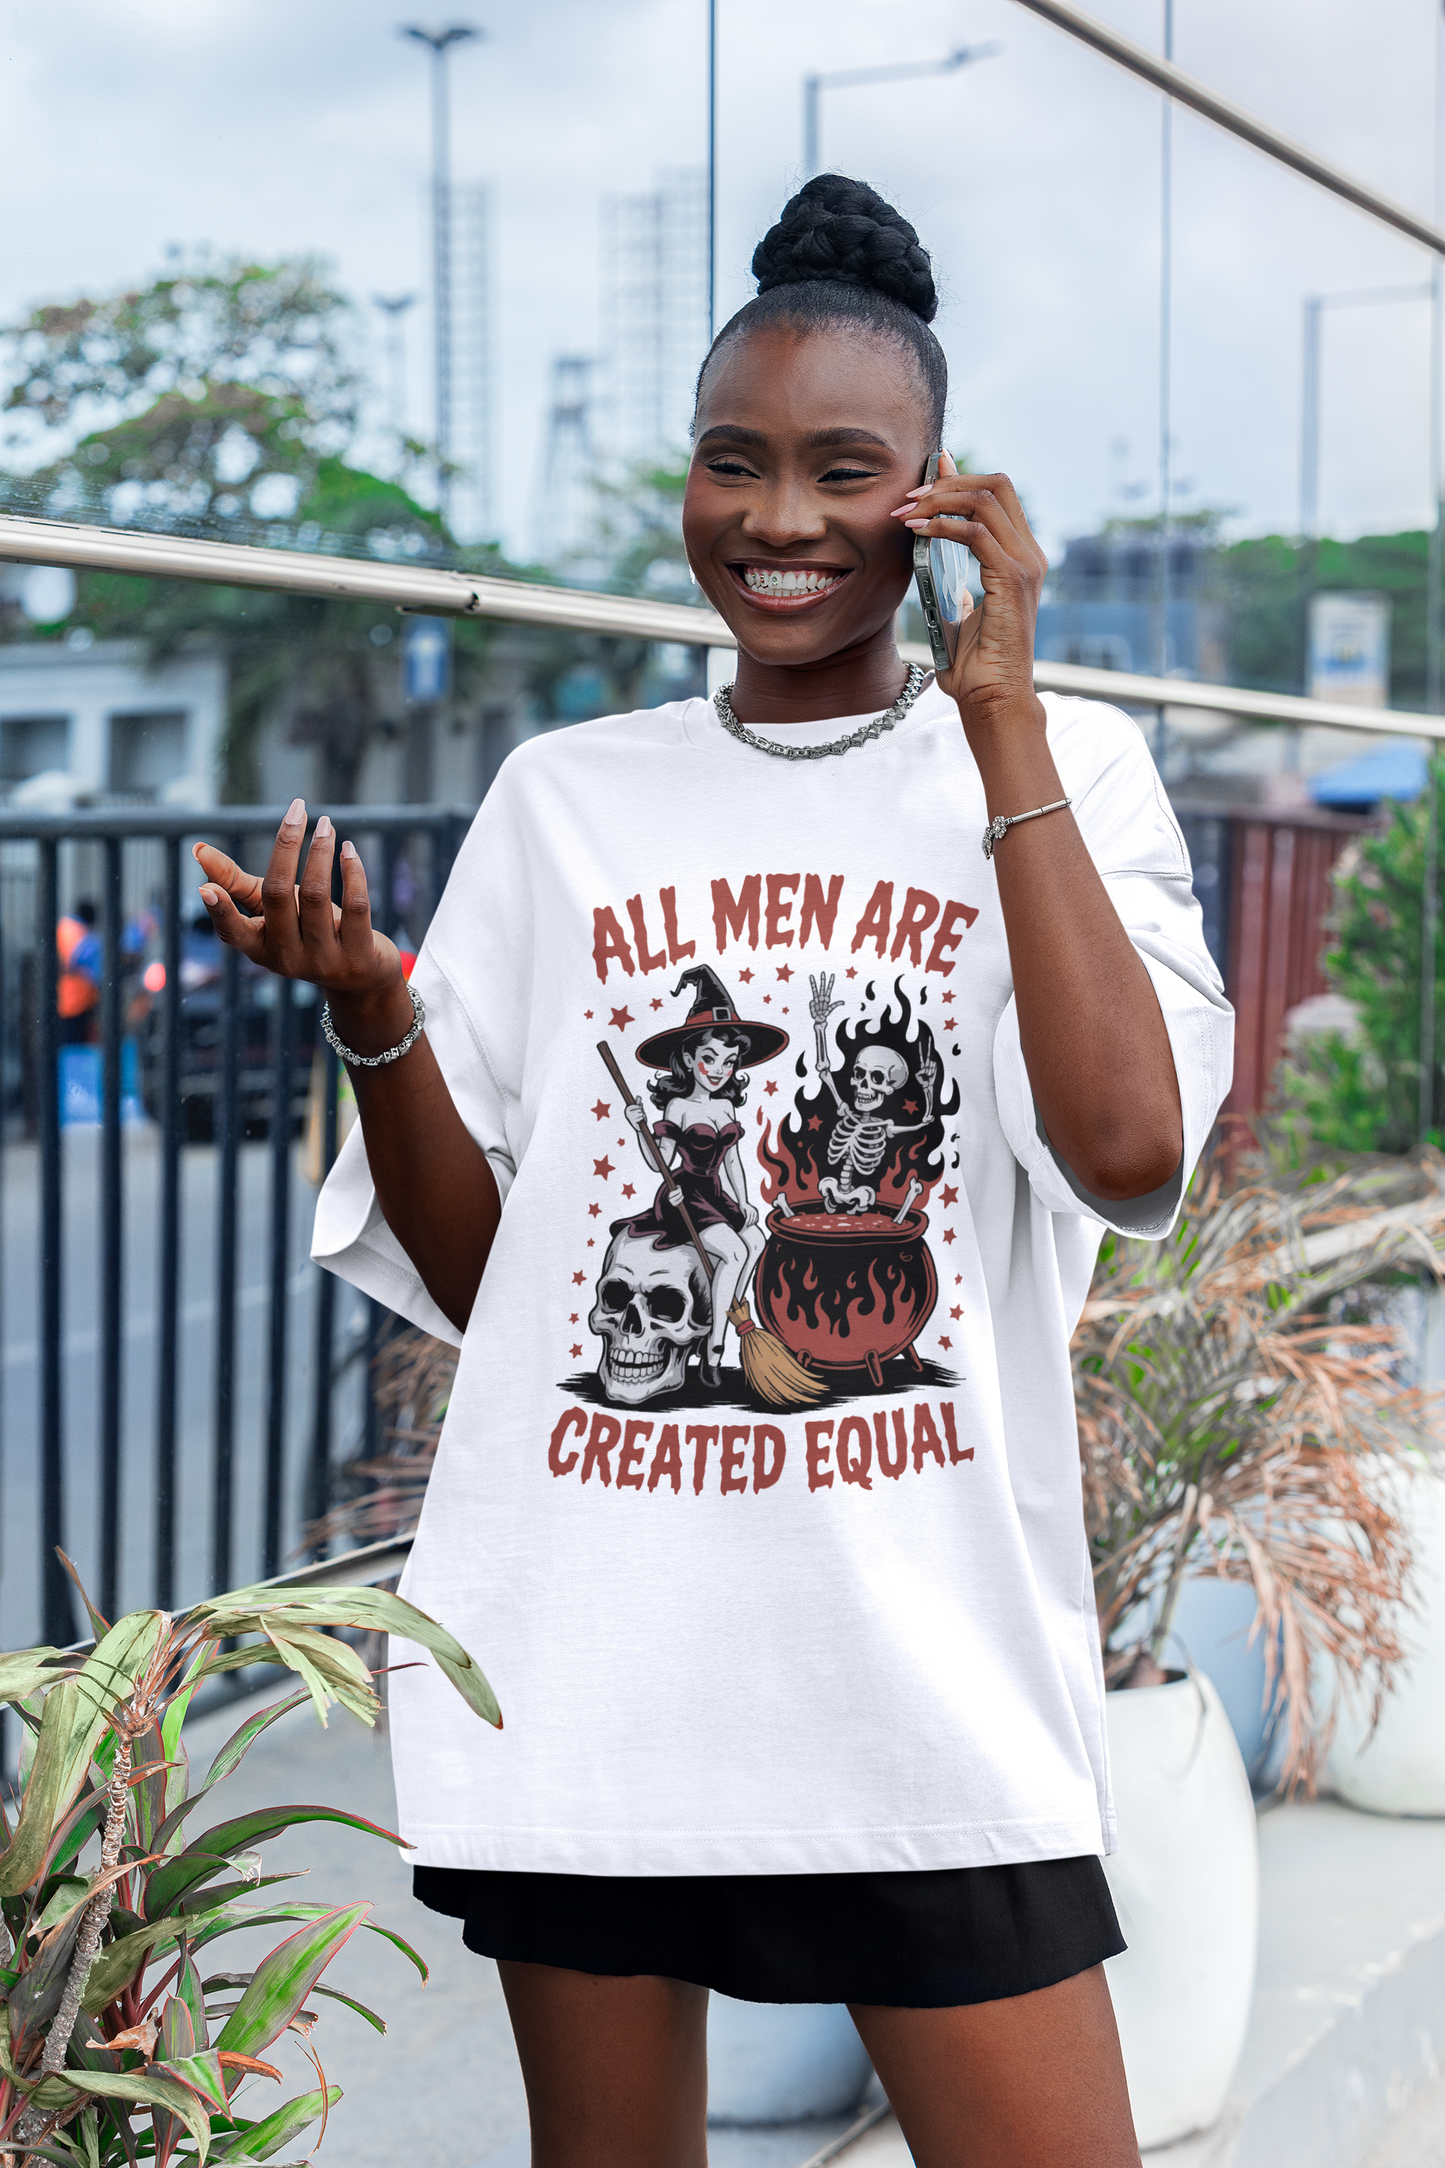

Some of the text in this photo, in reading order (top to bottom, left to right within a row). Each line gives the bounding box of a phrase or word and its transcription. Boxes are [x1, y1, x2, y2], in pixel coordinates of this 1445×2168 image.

[592, 873, 980, 984] ALL MEN ARE
[548, 1401, 976, 1496] CREATED EQUAL
